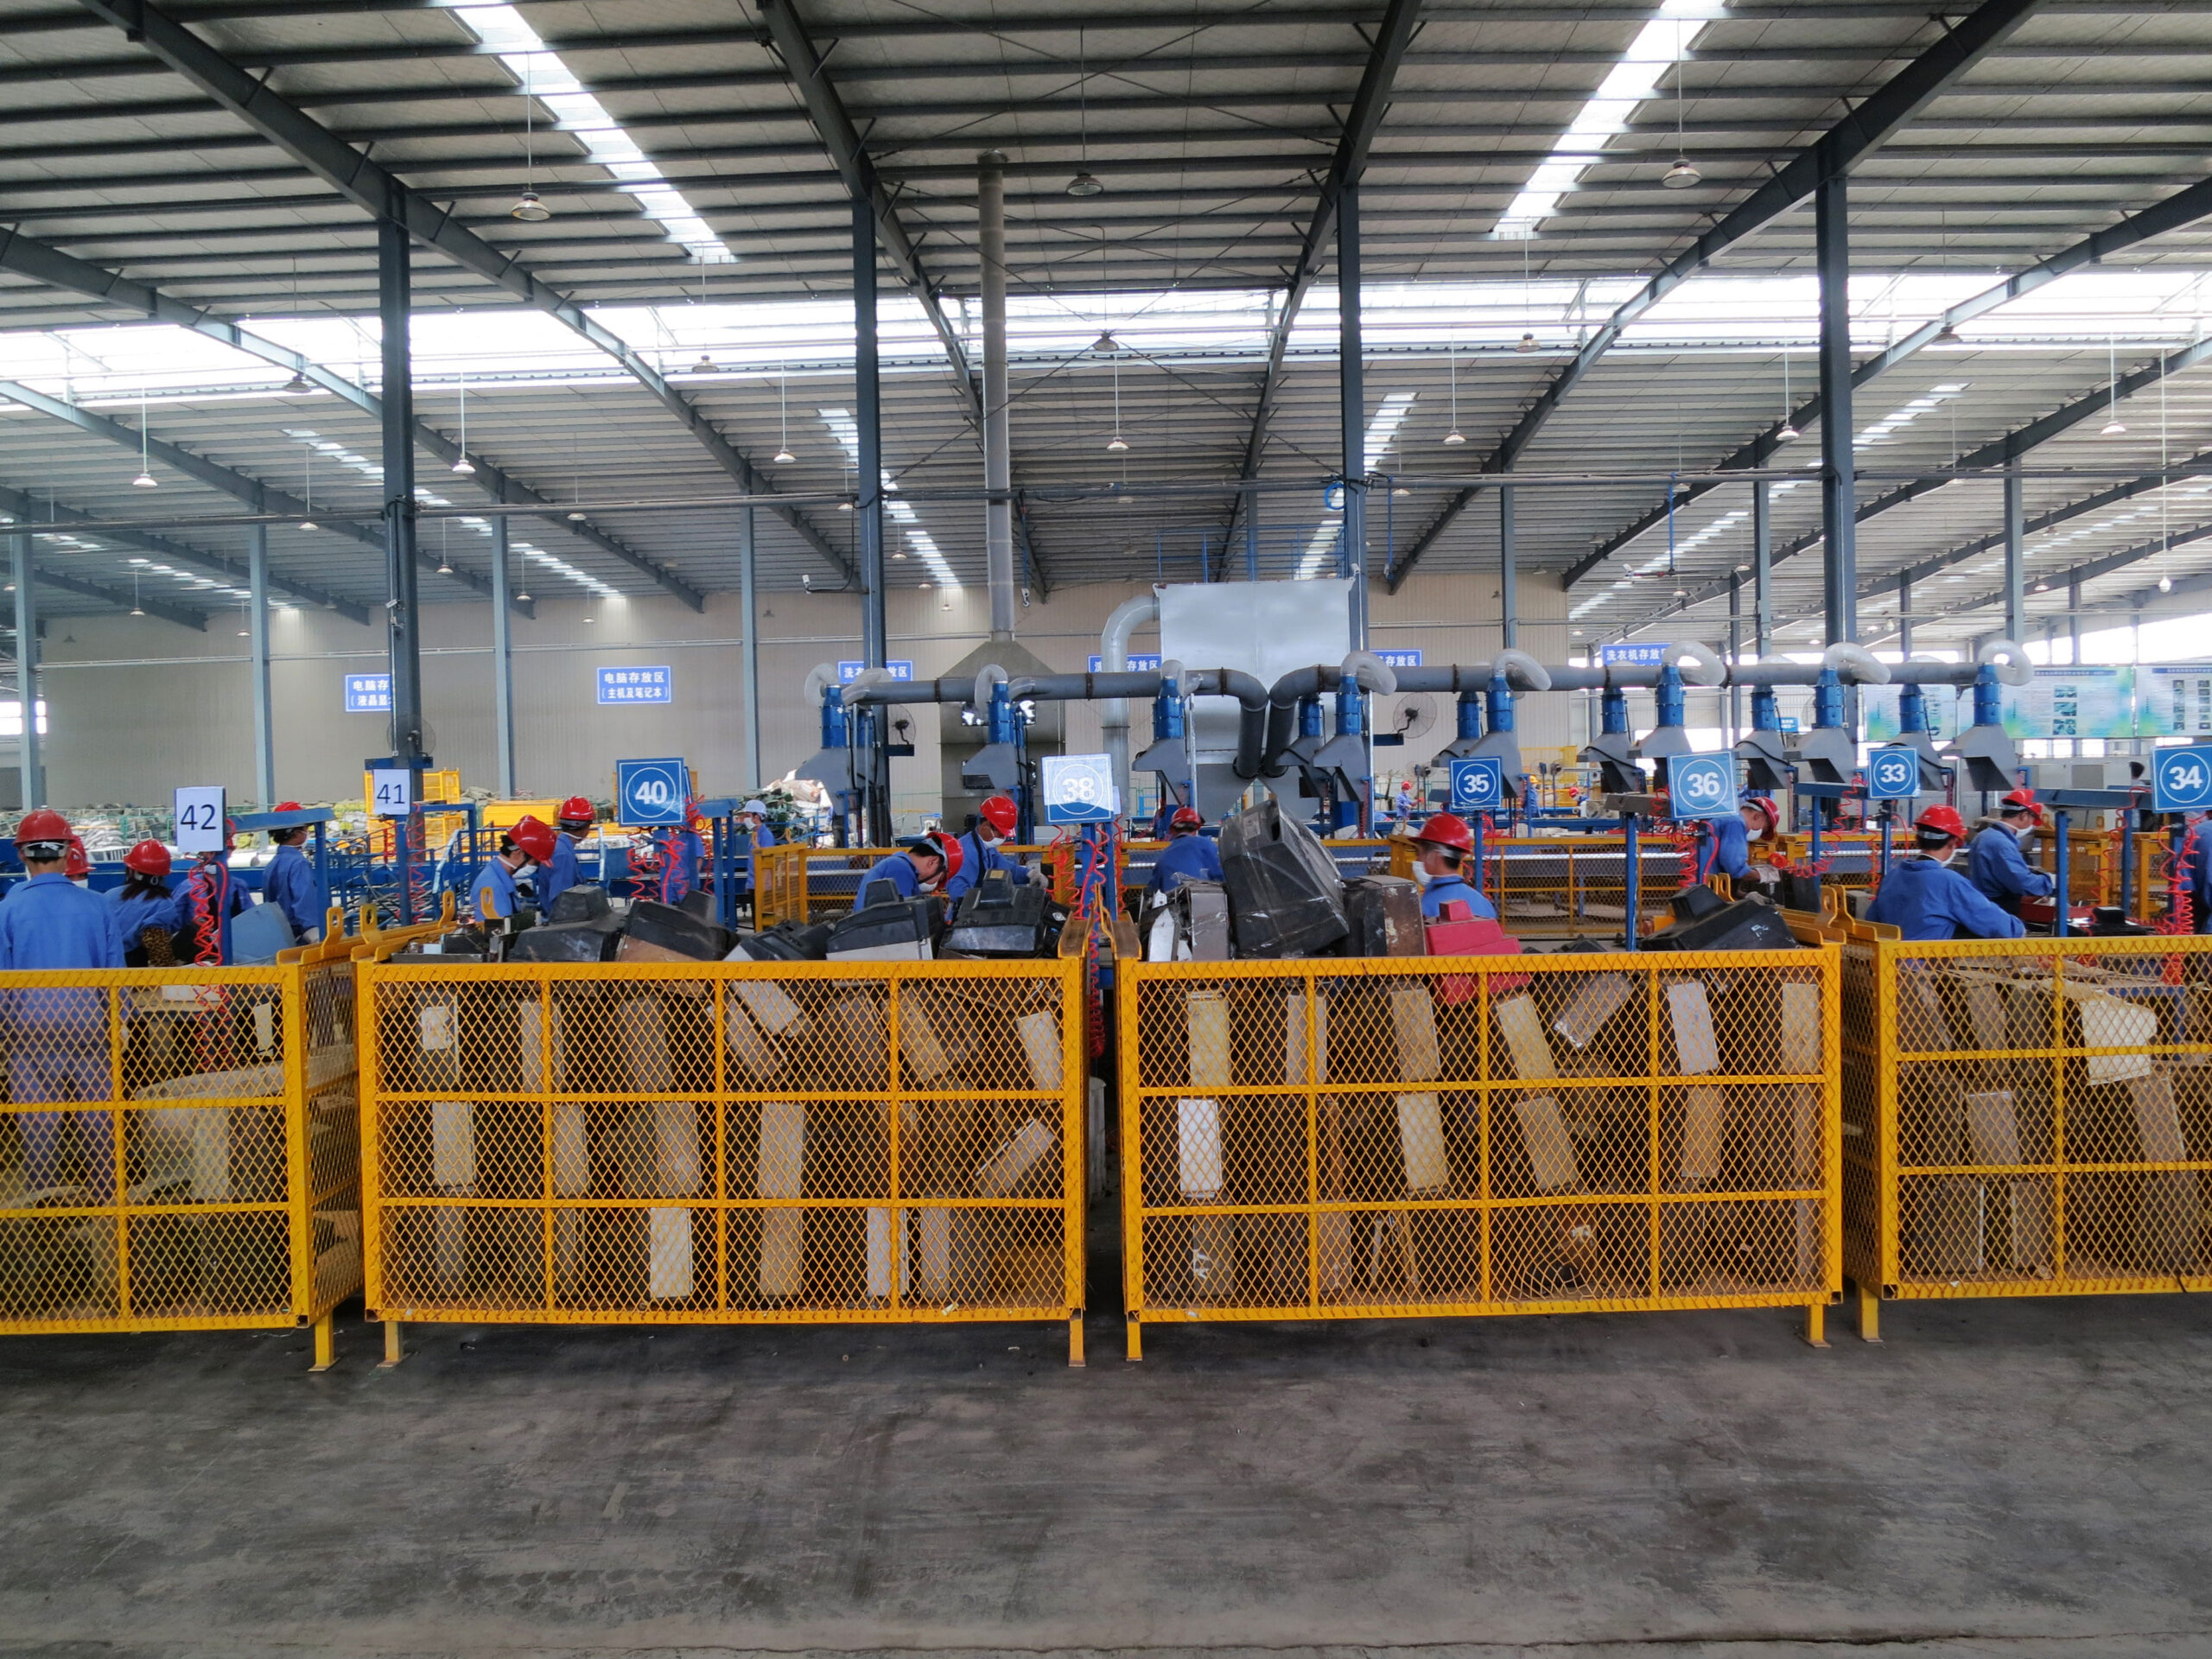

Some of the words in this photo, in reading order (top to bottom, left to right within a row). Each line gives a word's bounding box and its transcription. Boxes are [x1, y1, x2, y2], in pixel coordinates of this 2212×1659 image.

[605, 671, 664, 683] 电脑存放区
[1463, 774, 1489, 793] 35
[1687, 772, 1720, 798] 36
[1880, 763, 1905, 783] 33
[2170, 766, 2203, 790] 34
[376, 784, 405, 804] 41
[634, 780, 668, 804] 40
[1062, 777, 1095, 802] 38
[180, 804, 216, 830] 42
